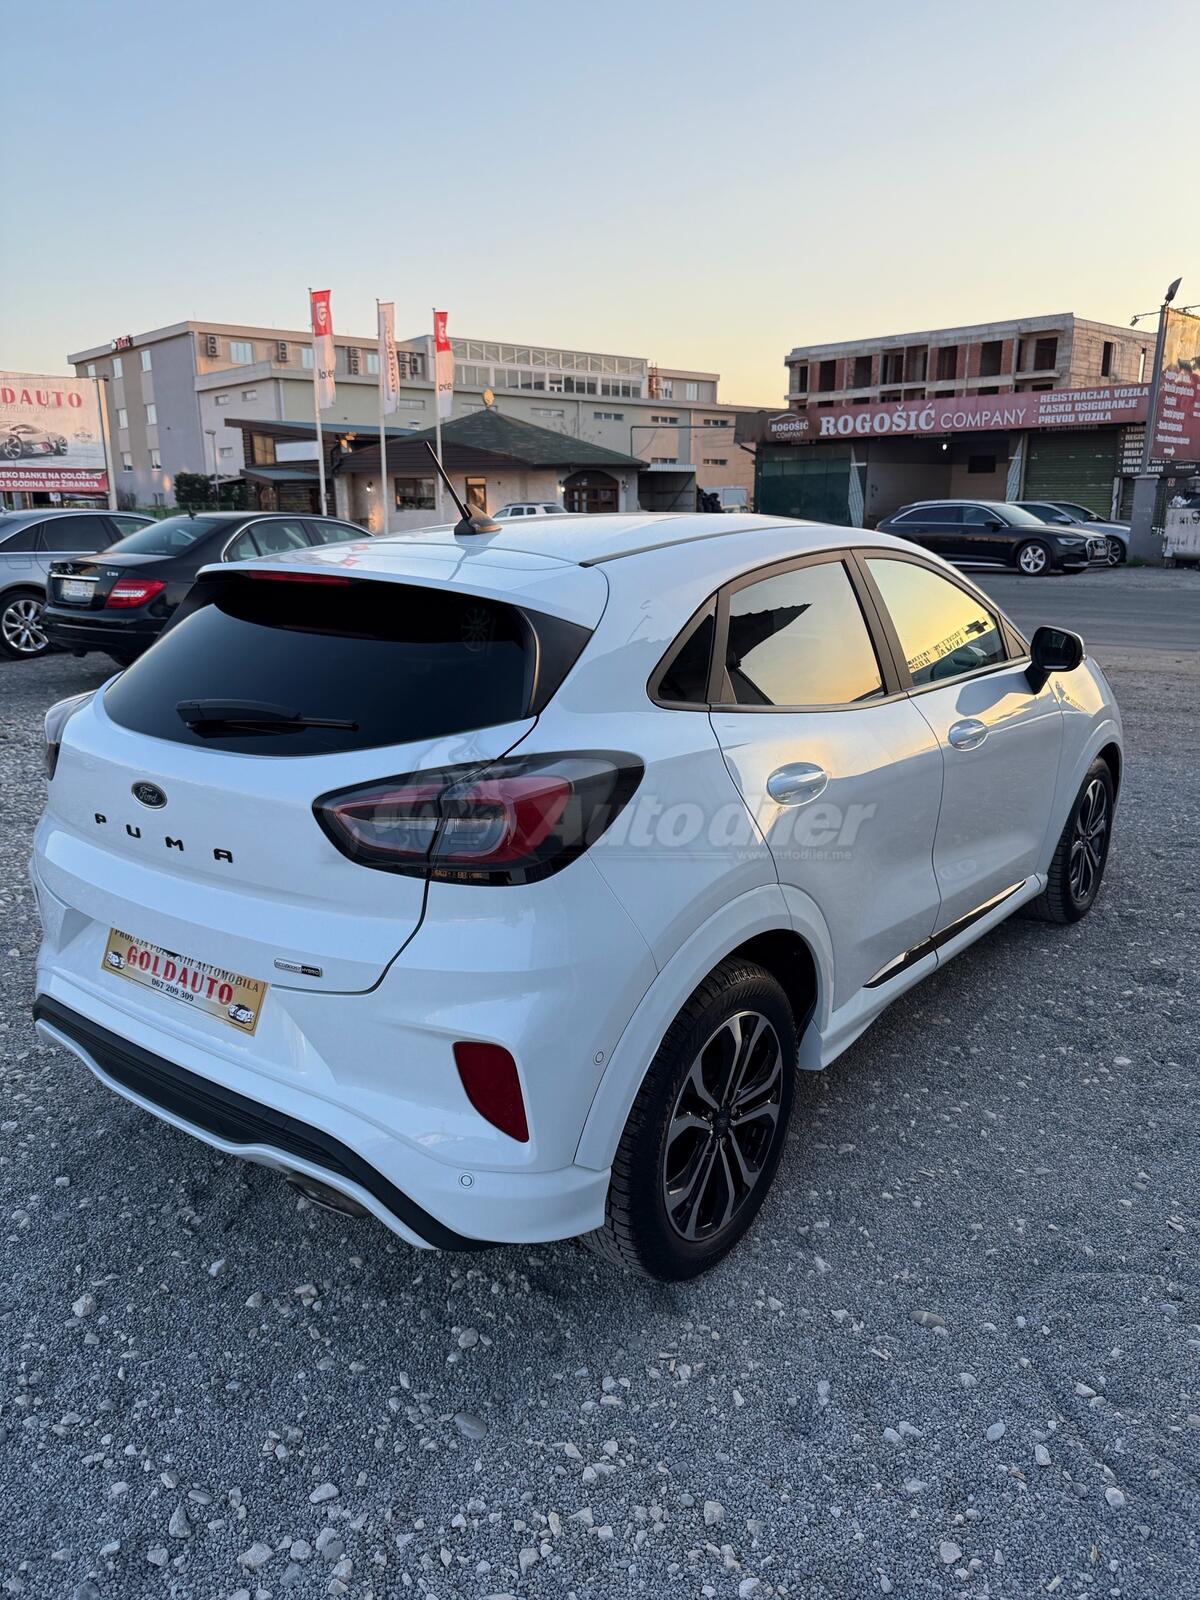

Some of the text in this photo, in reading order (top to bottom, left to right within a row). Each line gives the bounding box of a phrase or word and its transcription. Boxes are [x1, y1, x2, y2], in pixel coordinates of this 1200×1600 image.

[1039, 390, 1110, 403] REGISTRACIJA
[1114, 386, 1150, 397] VOZILA
[1039, 399, 1138, 414] KASKO OSIGURANJE
[771, 419, 809, 432] ROGOŠIĆ
[819, 403, 1027, 436] ROGOŠIĆ COMPANY
[1038, 411, 1112, 425] PREVOD VOZILA
[19, 471, 47, 479] BANKE
[48, 471, 60, 480] NA
[138, 786, 158, 803] Ford
[94, 812, 234, 864] PUMA
[127, 945, 234, 1006] GOLDAUTO
[195, 961, 259, 993] AUTOMOBILA
[151, 978, 194, 1002] 067 209 309
